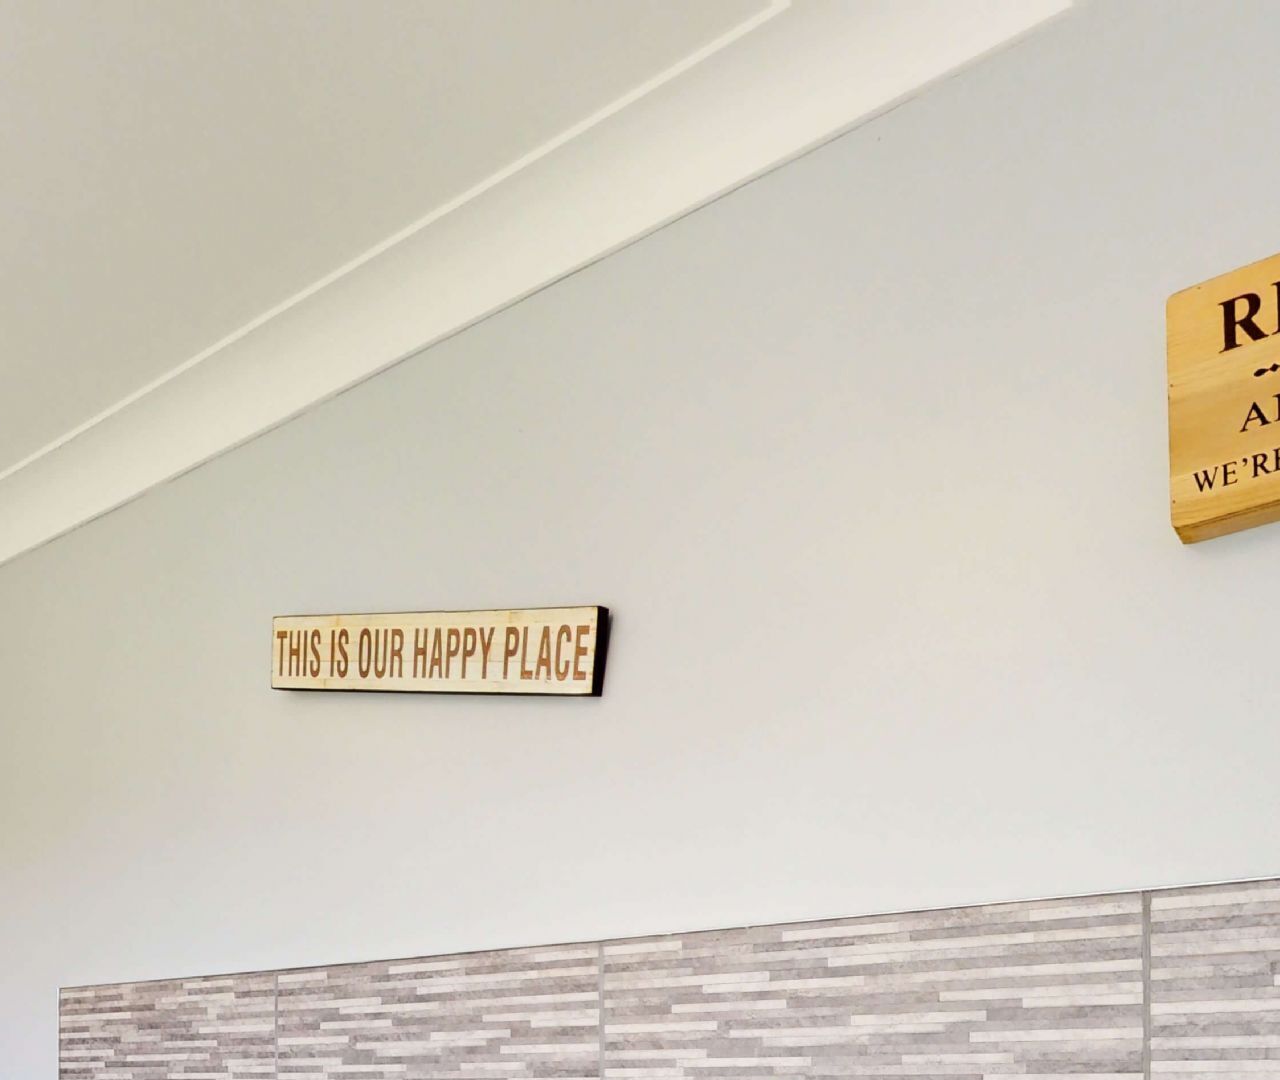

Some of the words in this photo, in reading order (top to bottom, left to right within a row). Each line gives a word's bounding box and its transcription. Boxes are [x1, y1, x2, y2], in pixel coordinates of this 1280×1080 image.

[277, 629, 321, 679] THIS
[330, 629, 350, 679] IS
[359, 628, 405, 679] OUR
[413, 627, 496, 680] HAPPY
[503, 624, 591, 682] PLACE
